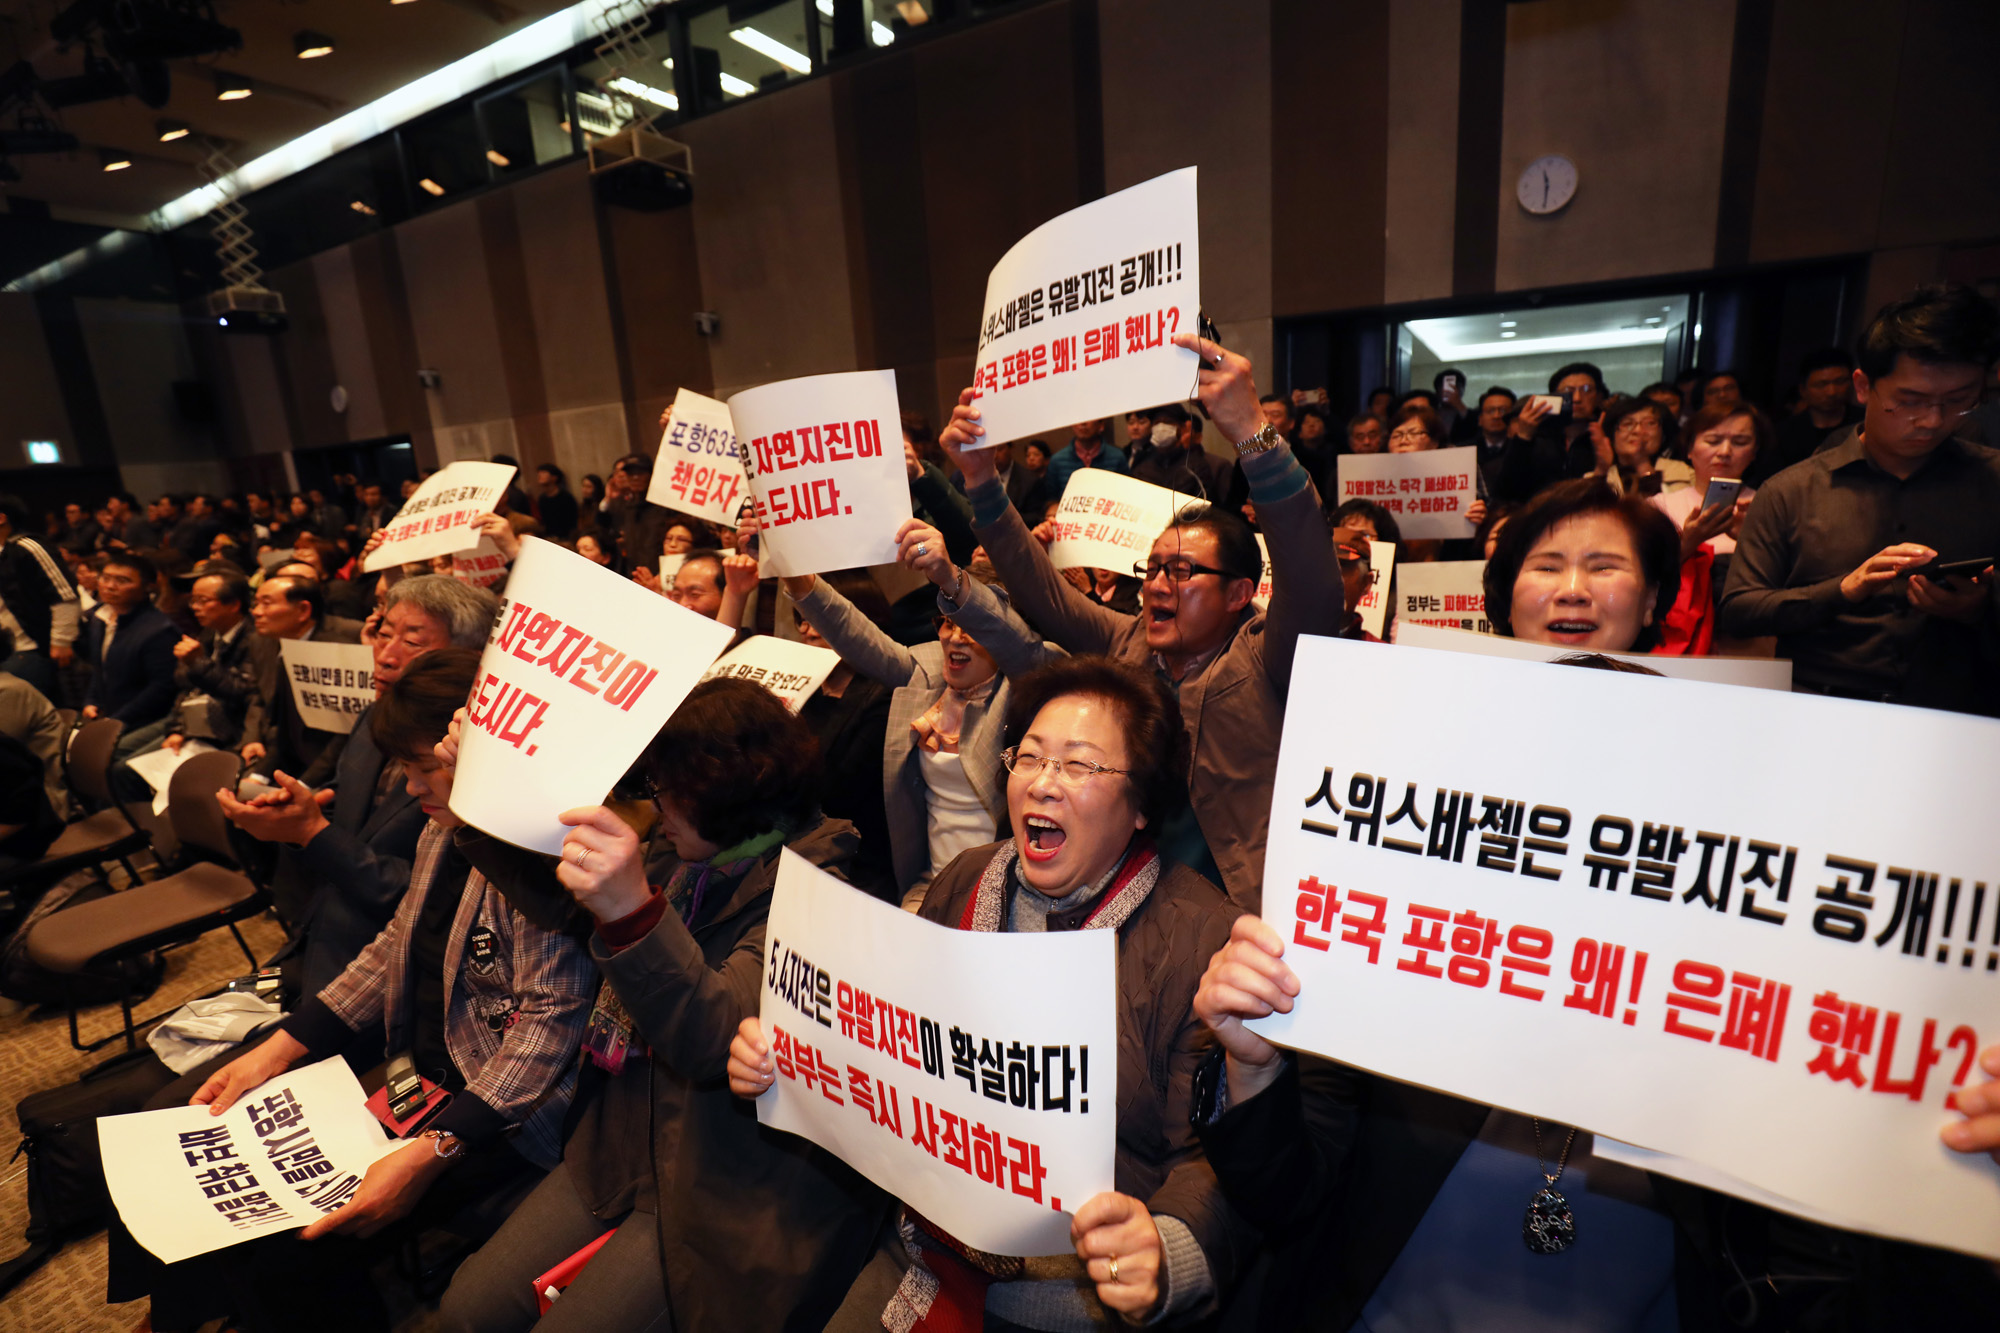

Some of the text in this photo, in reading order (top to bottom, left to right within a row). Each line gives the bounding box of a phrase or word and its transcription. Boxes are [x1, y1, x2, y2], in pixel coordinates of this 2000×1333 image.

[979, 241, 1182, 352] 스위스바젤은 유발지진 공개!!!
[972, 305, 1181, 400] 한국 포항은 왜! 은폐 했나?
[670, 459, 741, 514] 책임자
[752, 419, 883, 476] 자연지진이
[1345, 479, 1397, 496] 지열발전소
[768, 478, 853, 528] 도시다.
[1084, 523, 1110, 542] 즉시
[1407, 496, 1459, 514] 수립하라
[1407, 594, 1441, 612] 정부는
[345, 669, 354, 688] 더
[496, 601, 660, 713] 자연지진이
[470, 673, 552, 757] 도시다.
[1300, 765, 1573, 882] 스위스바젤은
[1583, 813, 1799, 926] 유발지진
[768, 937, 1089, 1114] 5.4지진은 유발지진이 확실하다!
[1293, 875, 1979, 1110] 한국 포항은 왜! 은폐 했나?
[245, 1087, 335, 1185] 포항시민을
[294, 1170, 348, 1199] 더
[772, 1024, 1063, 1212] 정부는 즉시 사죄하라.
[178, 1124, 295, 1231] 바보 취급 말라!!
